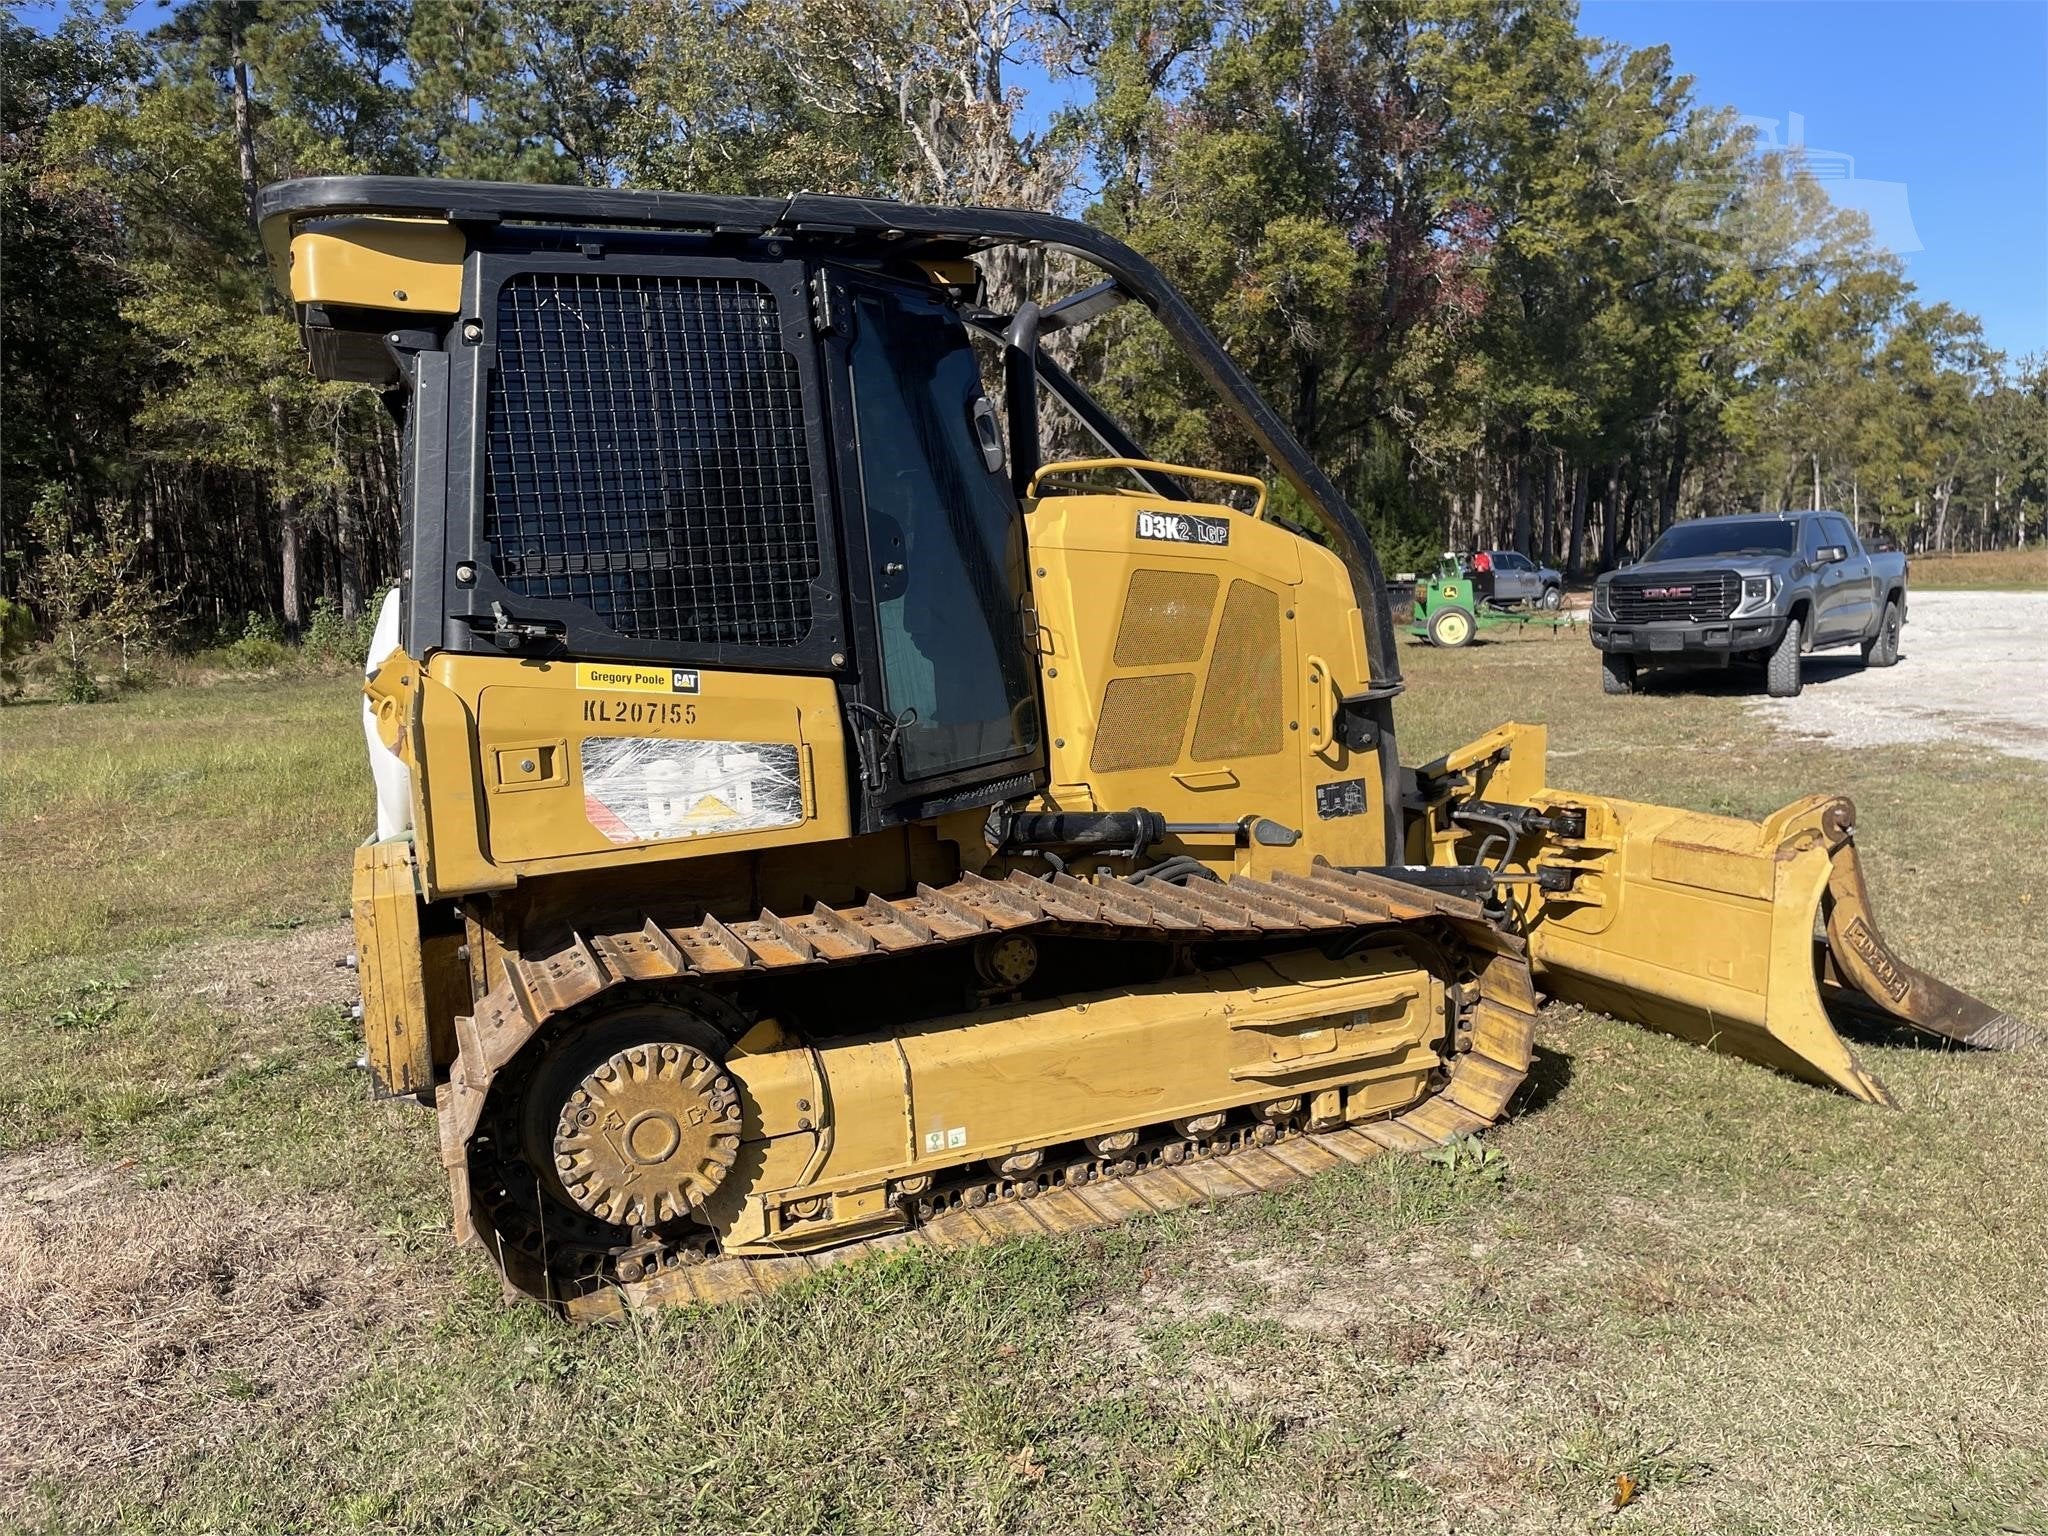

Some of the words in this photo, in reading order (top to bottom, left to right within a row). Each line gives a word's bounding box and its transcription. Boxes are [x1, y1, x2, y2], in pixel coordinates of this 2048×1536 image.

[1198, 525, 1228, 544] LGP
[1642, 586, 1692, 600] GMC
[591, 670, 632, 685] Gregory
[635, 673, 665, 685] Poole
[673, 673, 698, 688] CAT
[583, 700, 696, 725] KL207155
